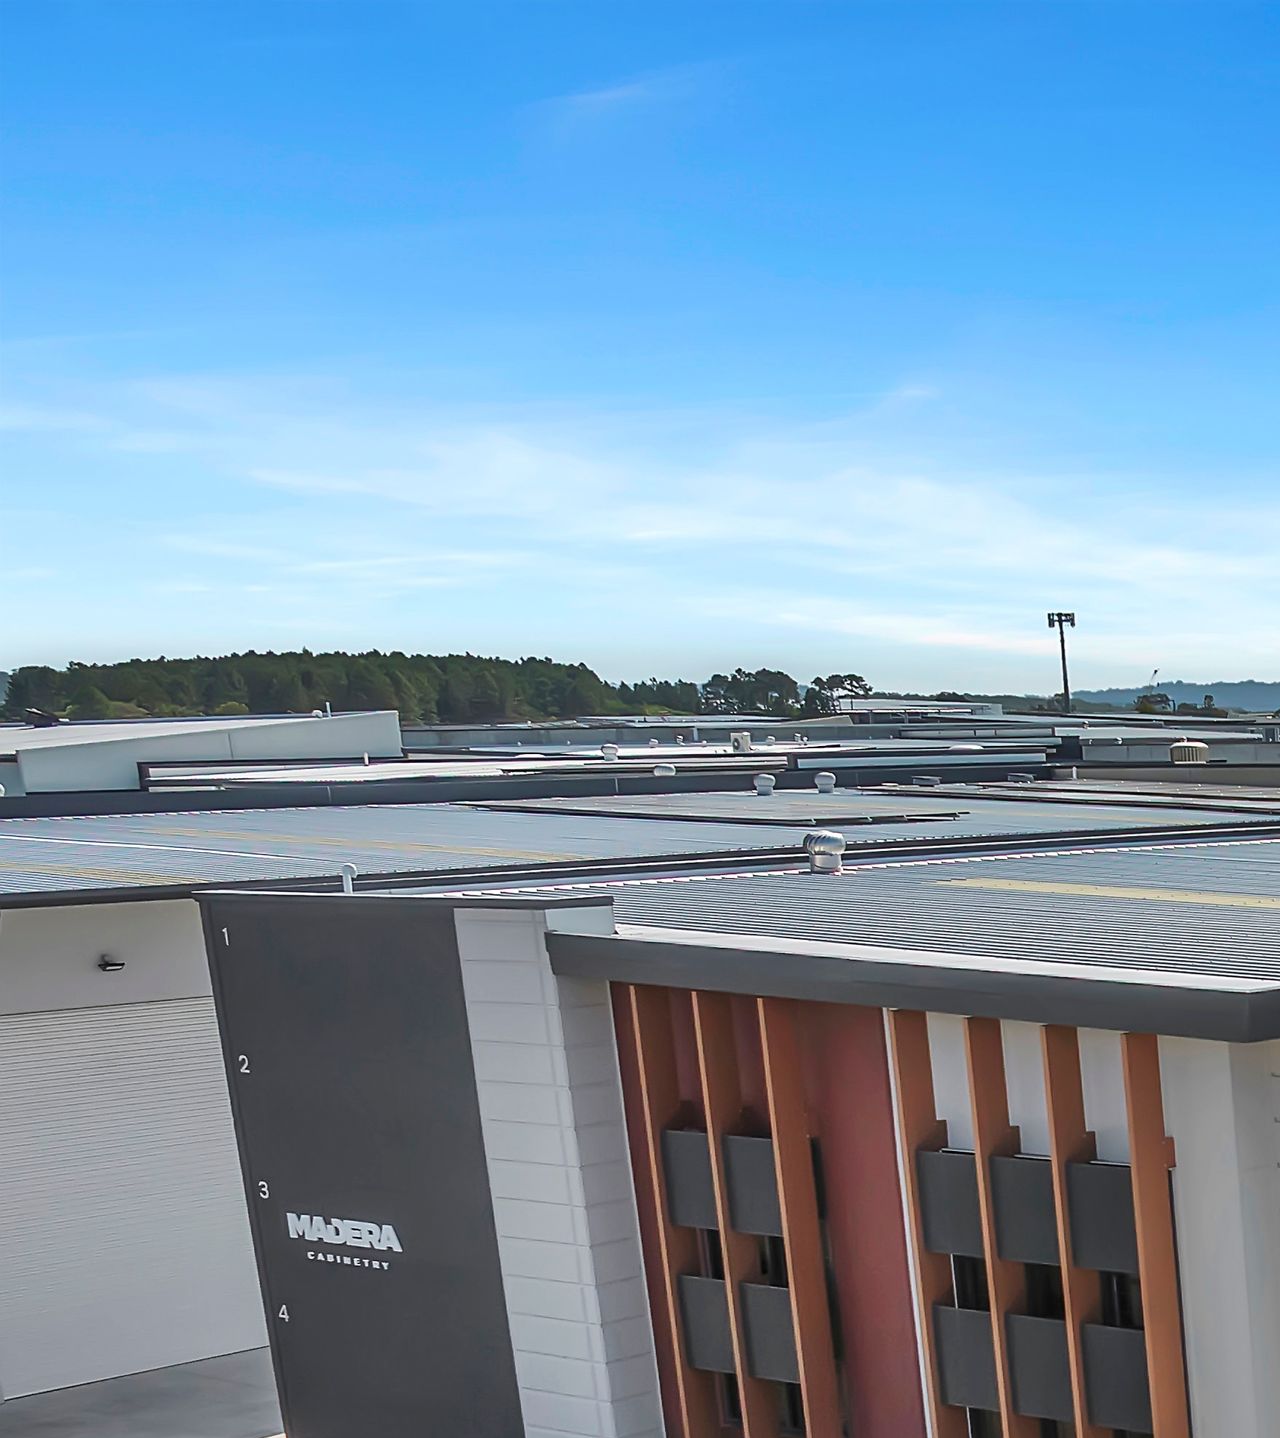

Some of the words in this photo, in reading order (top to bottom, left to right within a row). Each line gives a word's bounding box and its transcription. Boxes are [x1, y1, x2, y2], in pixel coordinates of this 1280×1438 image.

[221, 927, 231, 946] 1
[238, 1054, 251, 1074] 2
[258, 1180, 270, 1199] 3
[286, 1212, 403, 1253] MADERA
[307, 1251, 390, 1270] CABINETRY
[278, 1304, 290, 1322] 4
